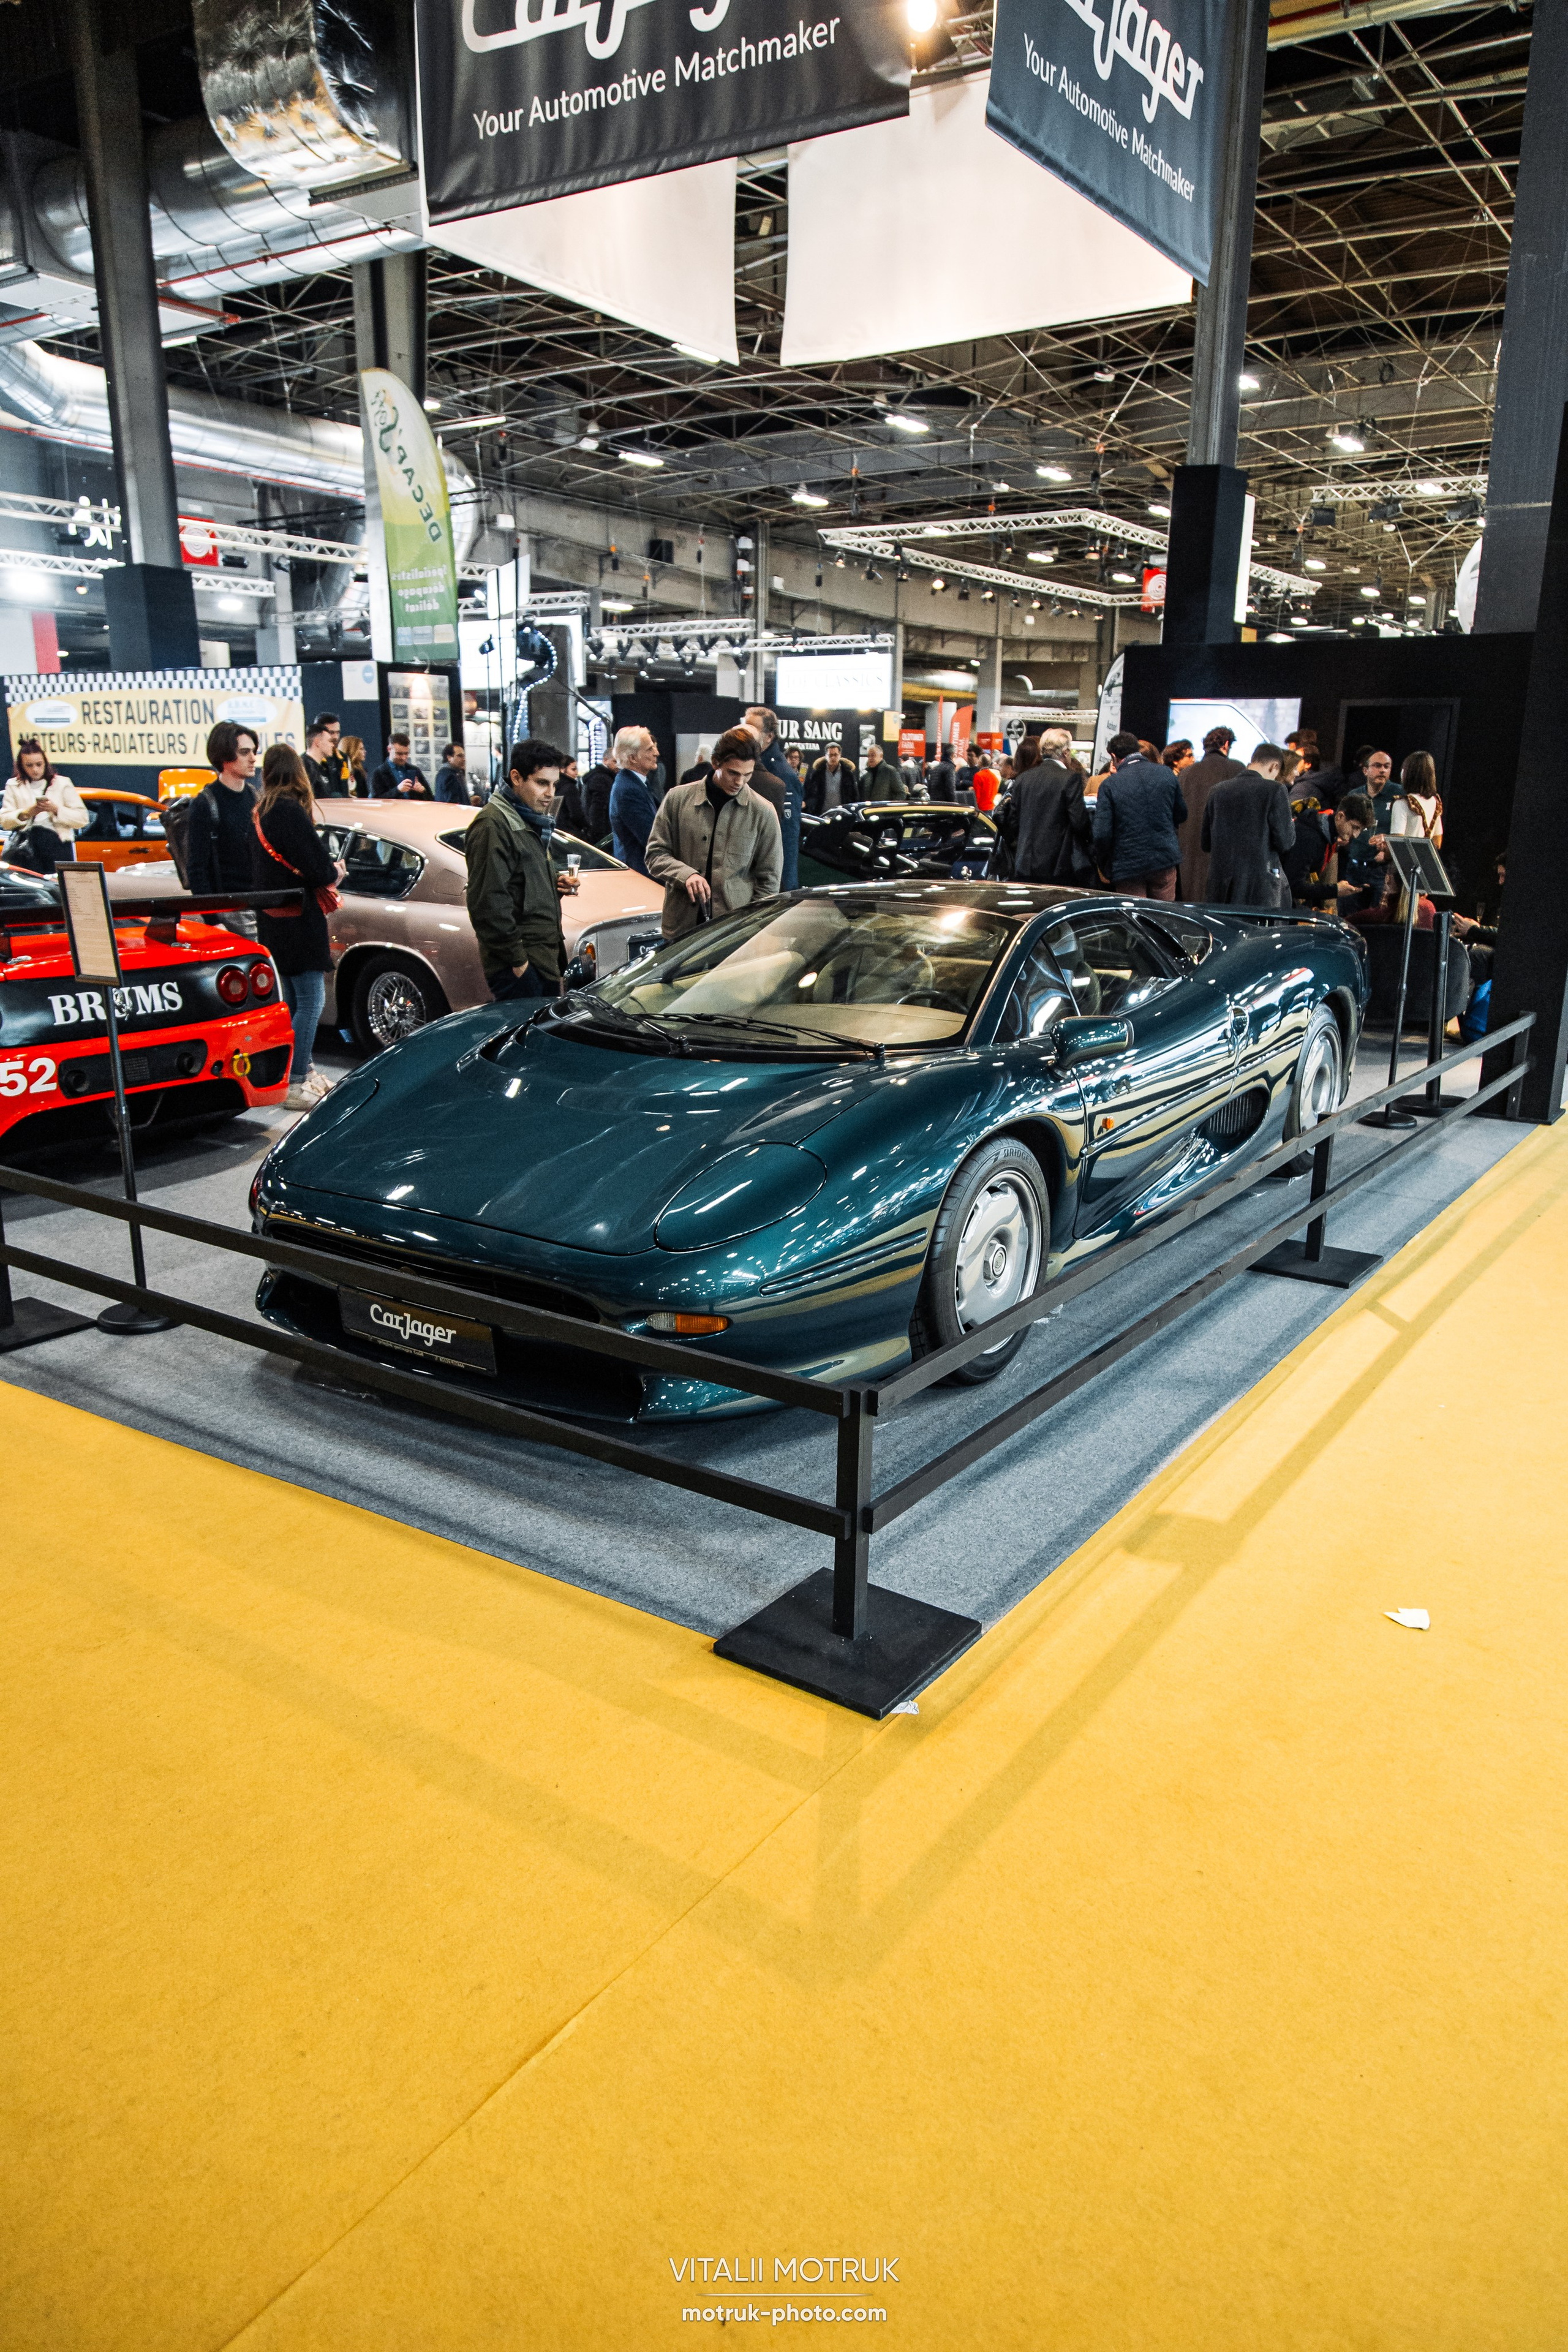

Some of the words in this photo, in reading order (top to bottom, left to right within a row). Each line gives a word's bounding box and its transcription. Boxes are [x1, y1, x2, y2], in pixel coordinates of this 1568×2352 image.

[473, 108, 523, 140] Your
[529, 68, 666, 126] Automotive
[674, 16, 842, 86] Matchmaker
[1023, 33, 1057, 87] Your
[1058, 66, 1128, 149] Automotive
[1132, 127, 1194, 203] Matchmaker
[81, 699, 215, 725] RESTAURATION
[778, 719, 800, 739] UR
[803, 720, 843, 742] SANG
[19, 732, 187, 754] TEURS-RADIATEURS
[0, 1057, 57, 1097] 52
[369, 1303, 456, 1346] CarJager
